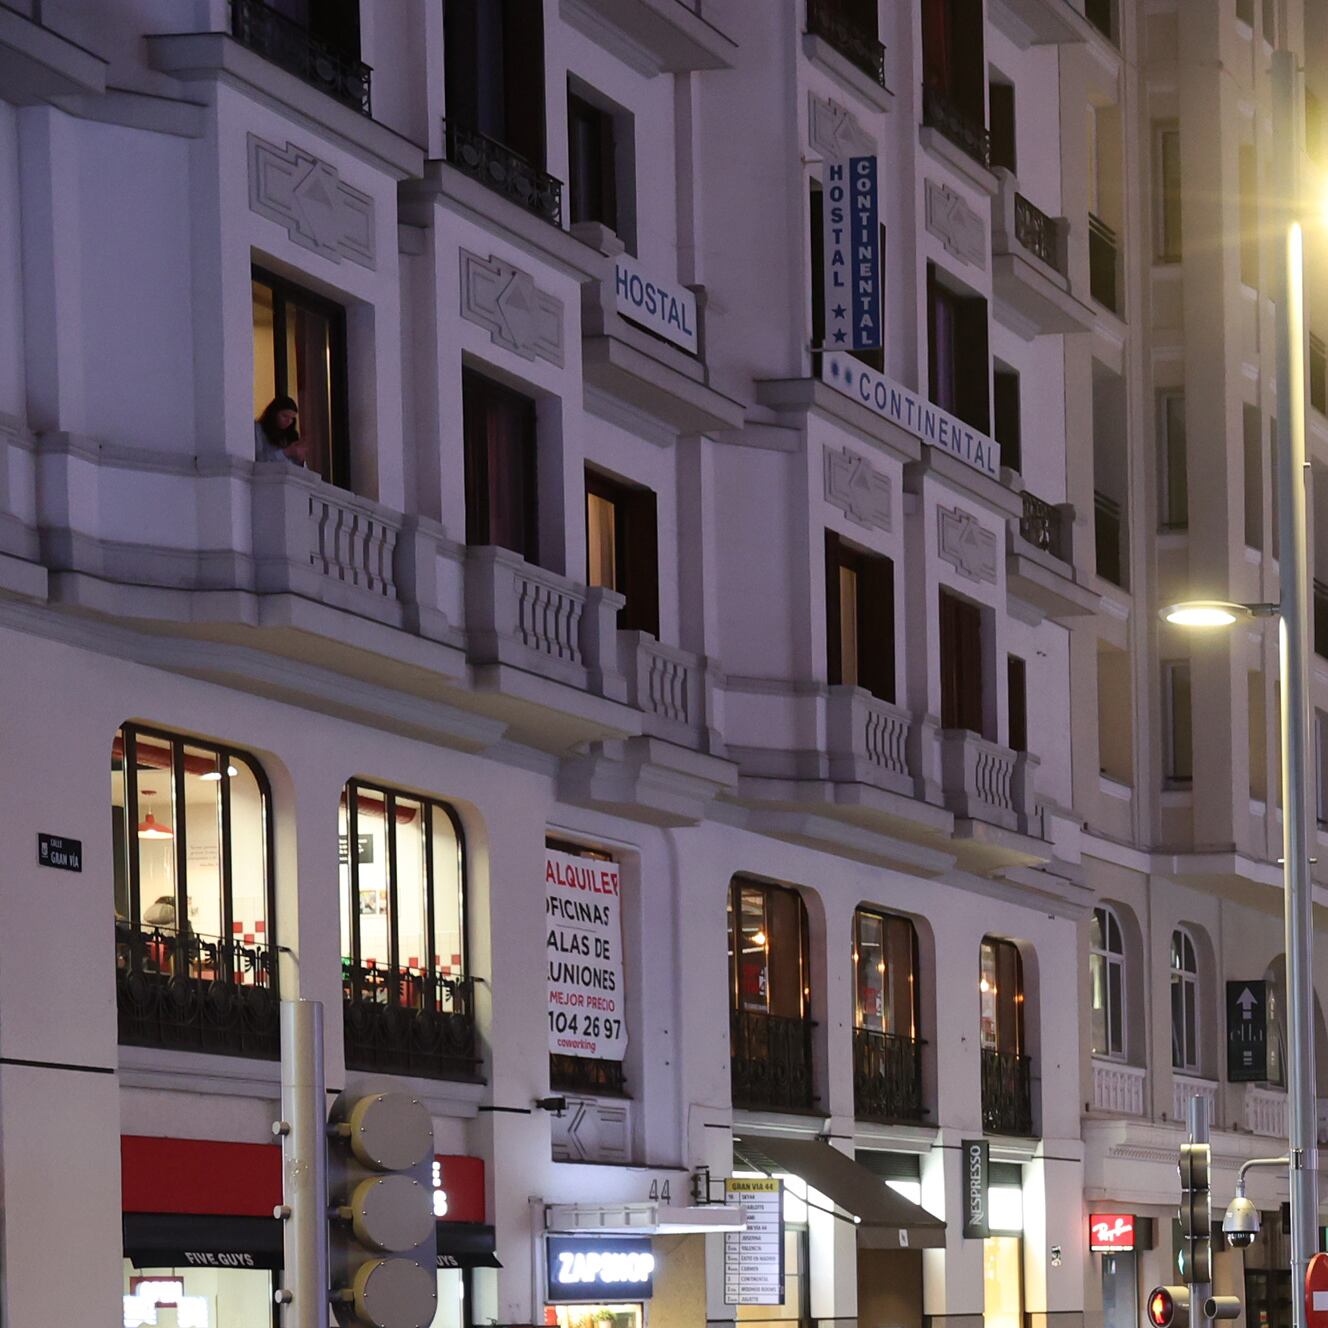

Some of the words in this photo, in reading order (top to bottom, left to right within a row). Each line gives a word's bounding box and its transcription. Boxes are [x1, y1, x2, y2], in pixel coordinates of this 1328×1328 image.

[829, 165, 845, 287] HOSTAL
[856, 160, 873, 345] CONTINENTAL
[616, 264, 693, 336] HOSTAL
[858, 371, 997, 474] CONTINENTAL
[547, 930, 590, 956] ALAS
[595, 938, 611, 960] DE
[548, 961, 616, 991] UNIONES
[549, 991, 585, 1008] MEJOR
[586, 996, 615, 1012] PRECIO
[583, 1015, 600, 1038] 26
[604, 1018, 621, 1040] 97
[557, 1039, 597, 1054] coworking
[649, 1178, 671, 1205] 44
[968, 1144, 983, 1226] NESPRESSO
[184, 1251, 218, 1267] FIVE
[217, 1252, 255, 1267] GUYS
[437, 1255, 458, 1267] UYS
